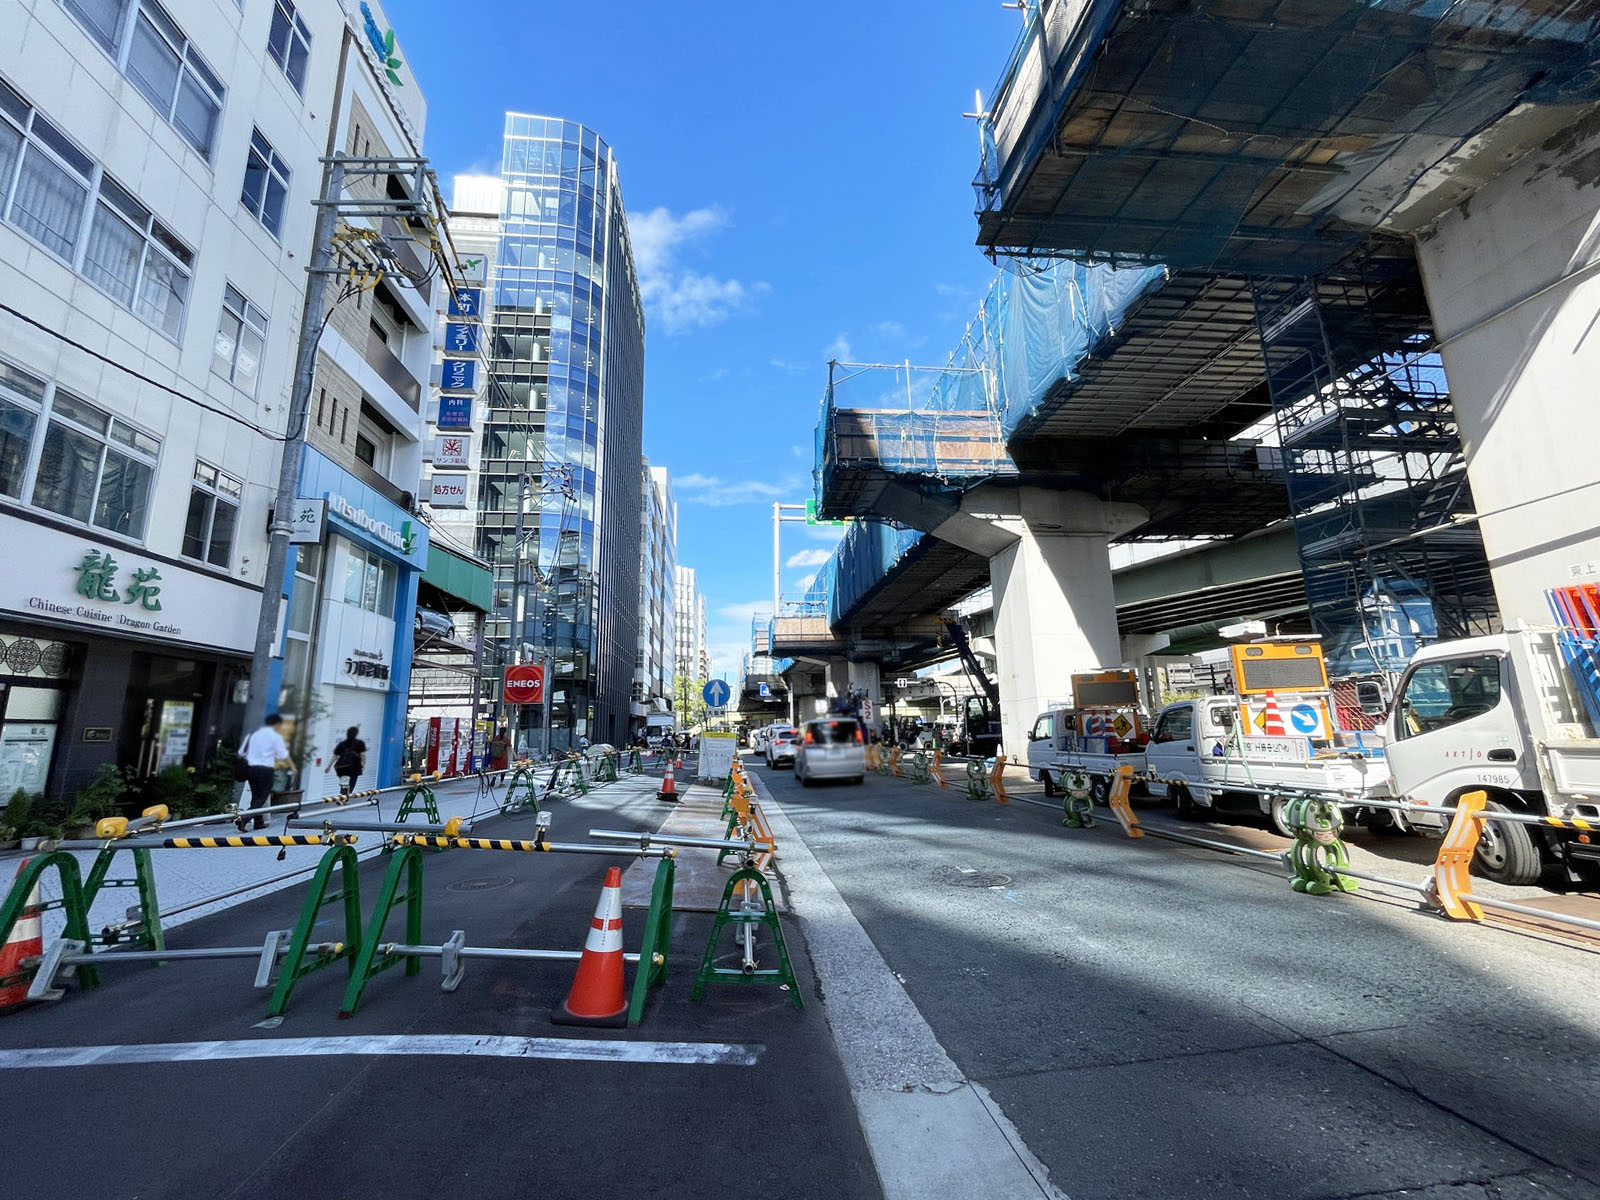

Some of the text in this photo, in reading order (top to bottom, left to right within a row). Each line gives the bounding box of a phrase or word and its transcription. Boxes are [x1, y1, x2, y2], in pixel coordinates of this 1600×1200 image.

[433, 484, 464, 495] 処方せん
[376, 521, 407, 552] Clinic
[74, 548, 163, 611] 龍苑
[29, 596, 182, 636] Chinese Cuisine Dragon Garden
[506, 679, 541, 688] ENEOS
[1477, 774, 1510, 784] 147985
